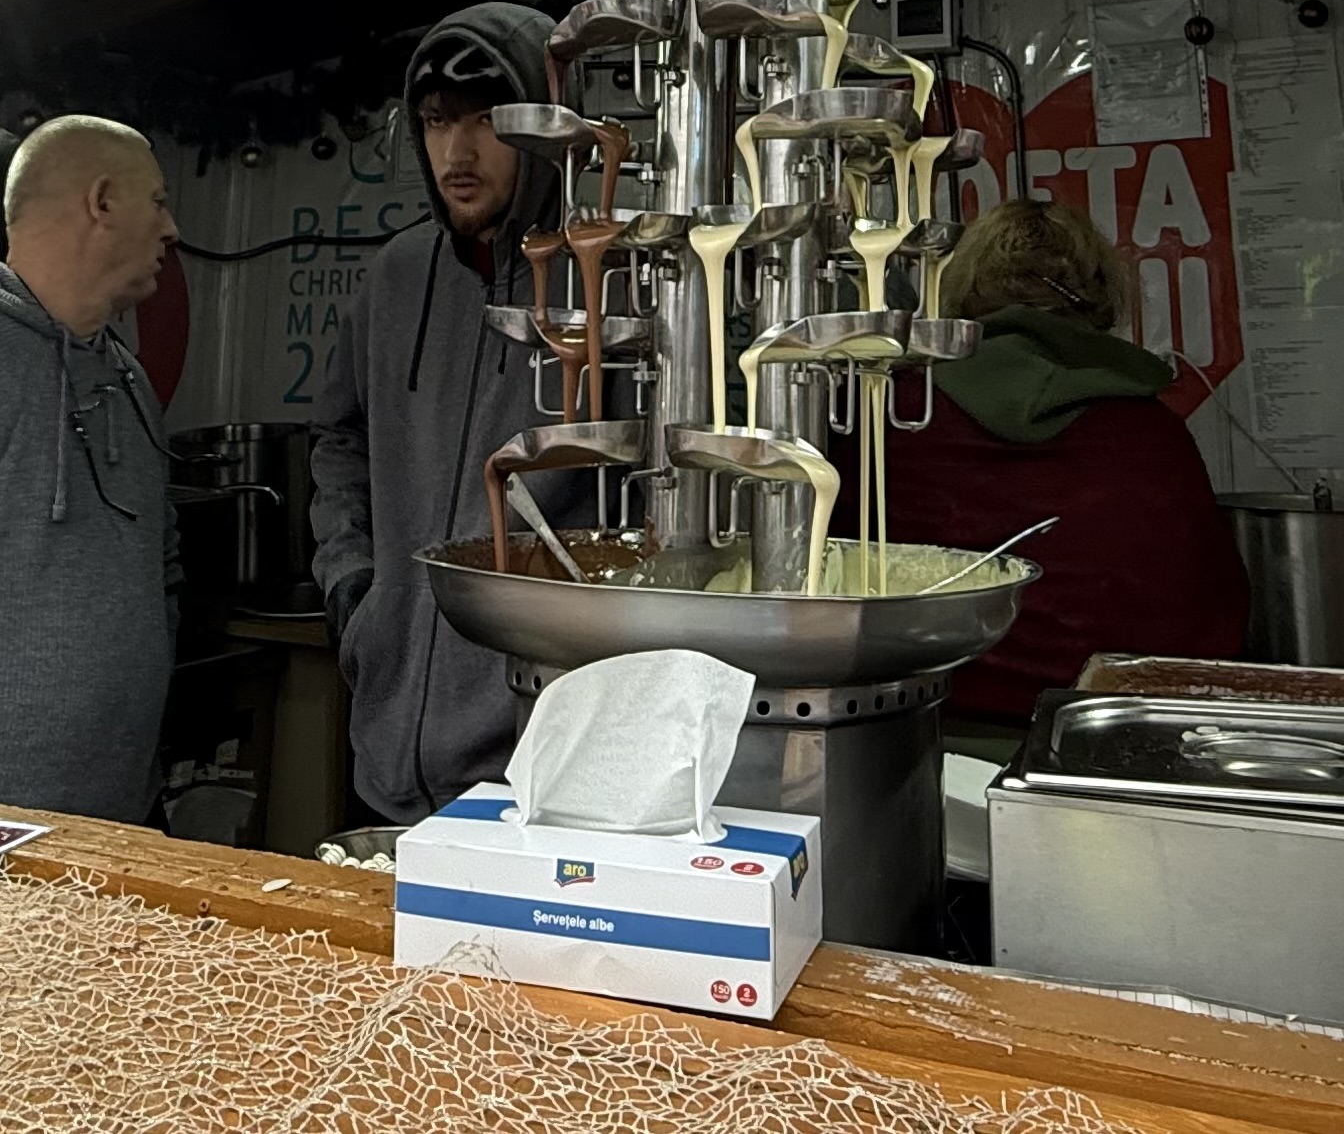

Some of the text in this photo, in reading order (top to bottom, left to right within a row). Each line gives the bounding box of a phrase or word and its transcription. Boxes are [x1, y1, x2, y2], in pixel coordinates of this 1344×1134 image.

[563, 862, 587, 876] aro
[589, 920, 614, 932] albe
[713, 984, 729, 994] 150
[744, 988, 750, 997] 2
